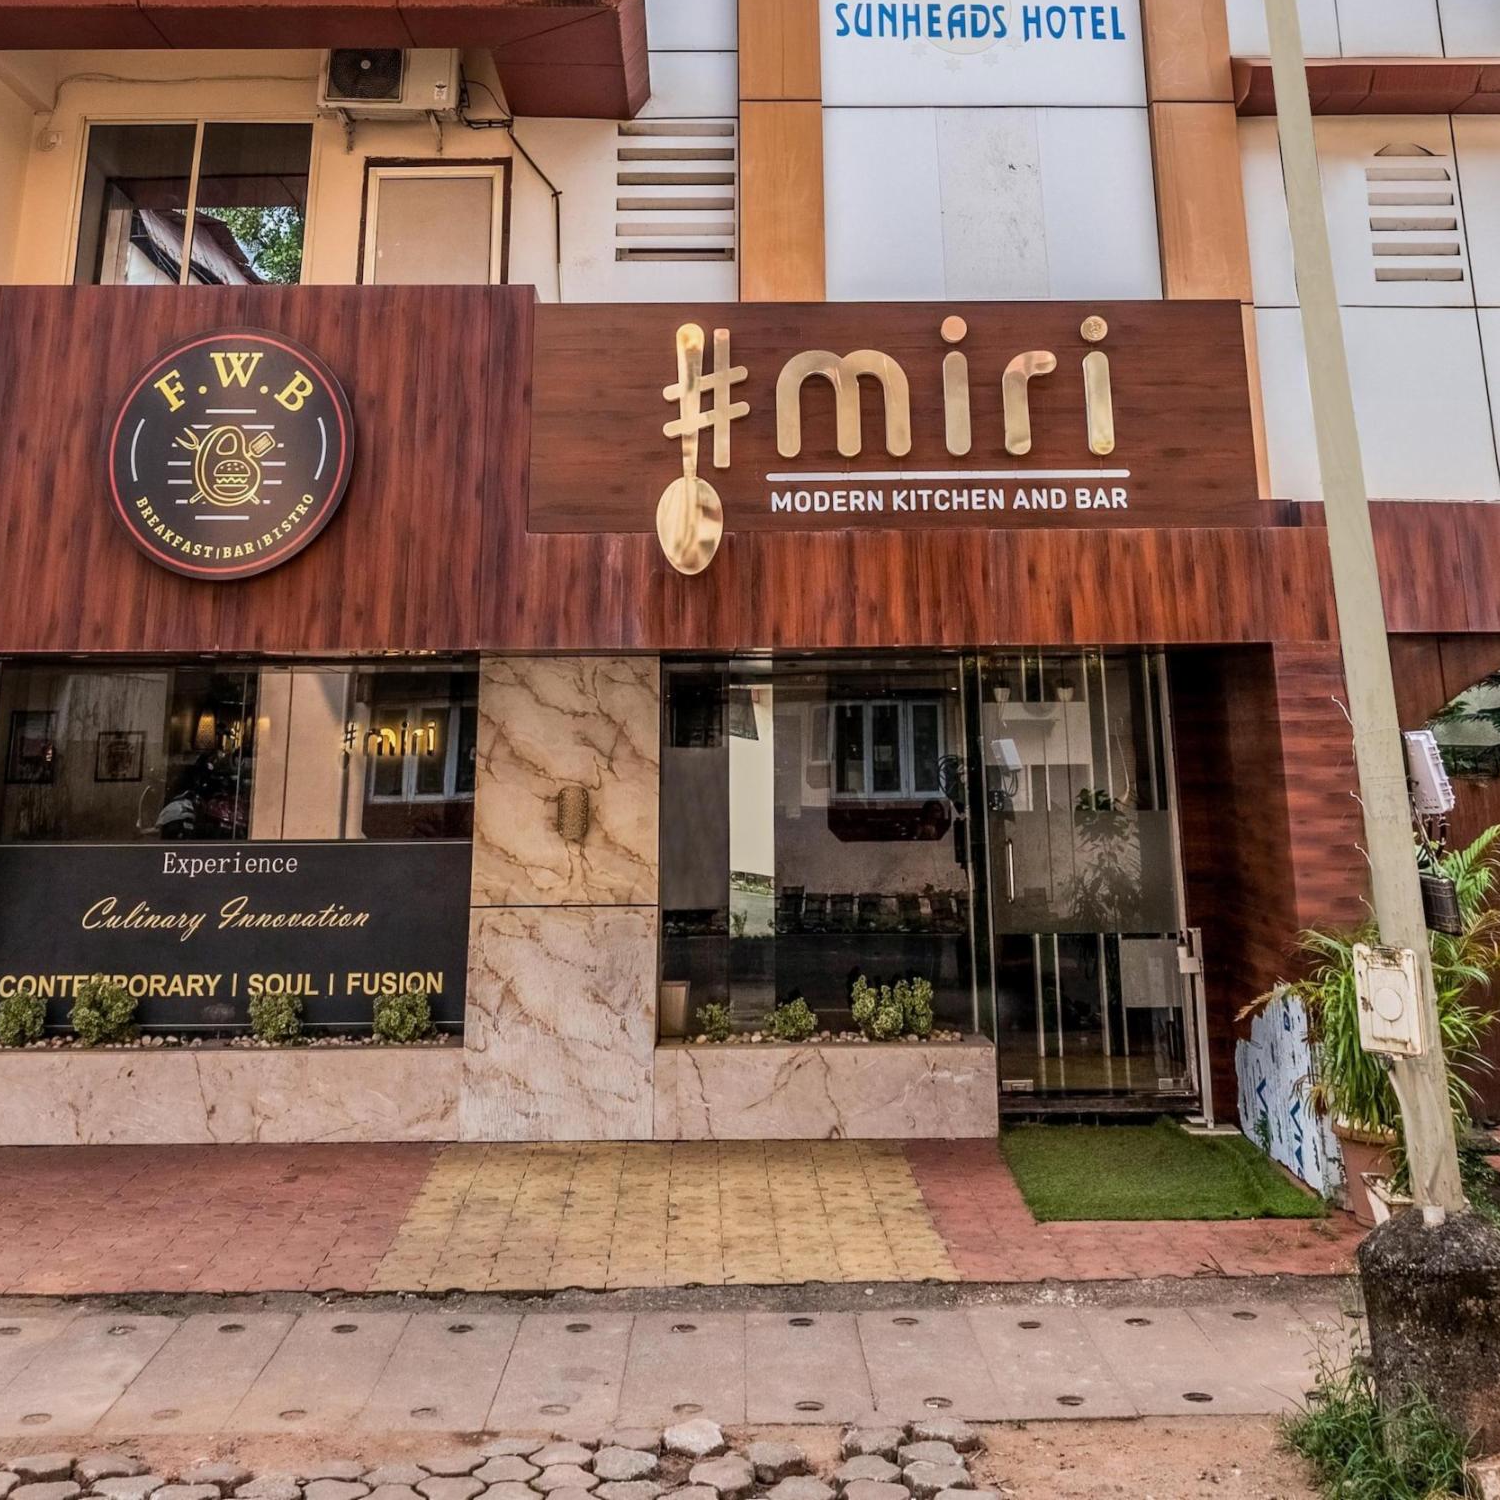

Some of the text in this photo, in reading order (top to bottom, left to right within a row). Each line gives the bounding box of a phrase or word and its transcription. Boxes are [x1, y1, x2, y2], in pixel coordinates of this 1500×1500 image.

[835, 3, 1126, 42] SUNHEADS HOTEL
[771, 487, 1128, 513] MODERN KITCHEN AND BAR
[162, 851, 298, 877] Experience
[81, 896, 370, 942] Culinary Innovation
[247, 973, 319, 996] SOUL
[346, 972, 443, 995] FUSION
